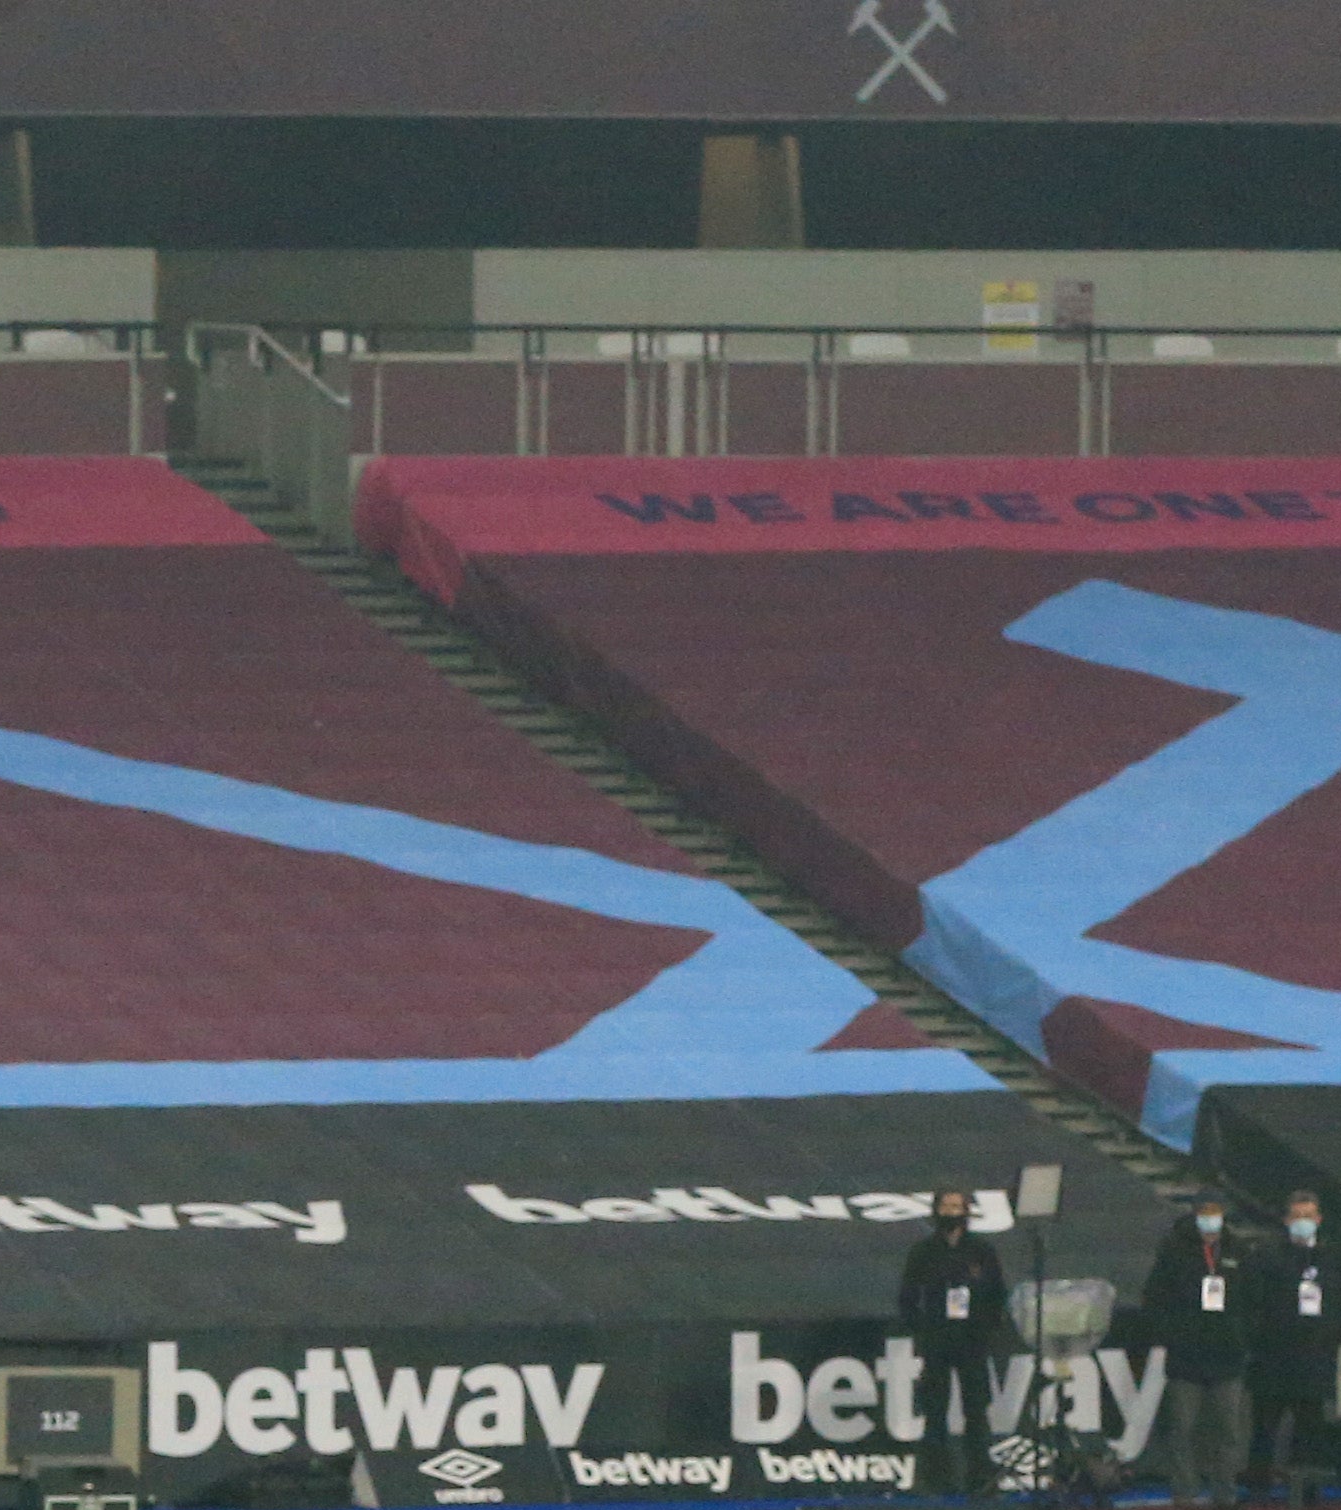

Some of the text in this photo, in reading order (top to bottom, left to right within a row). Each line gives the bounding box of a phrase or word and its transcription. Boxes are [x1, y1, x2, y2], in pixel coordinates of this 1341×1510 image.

[594, 492, 807, 524] WE
[830, 491, 1063, 524] ARE
[1074, 490, 1328, 523] ONE
[147, 1340, 606, 1458] betway
[40, 1410, 80, 1432] 112
[568, 1450, 734, 1493] betway
[758, 1447, 917, 1490] betway
[434, 1486, 504, 1503] umbro
